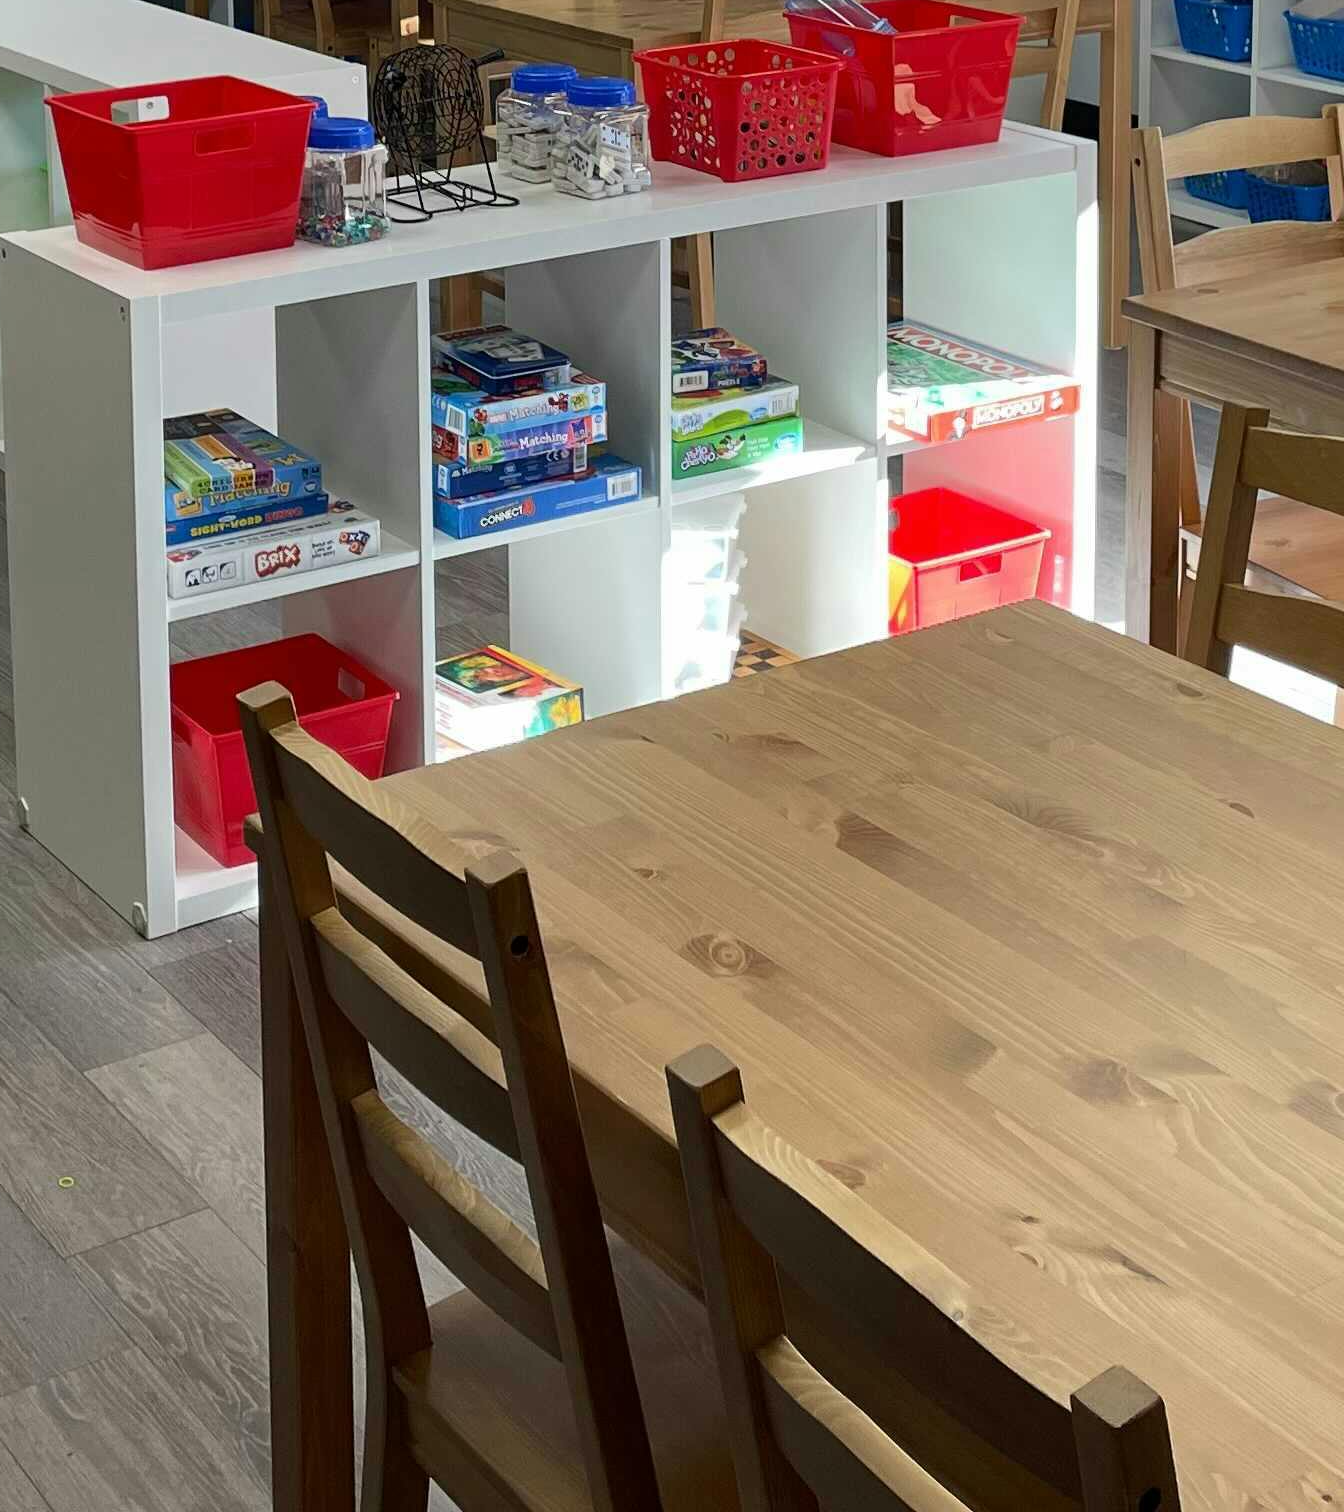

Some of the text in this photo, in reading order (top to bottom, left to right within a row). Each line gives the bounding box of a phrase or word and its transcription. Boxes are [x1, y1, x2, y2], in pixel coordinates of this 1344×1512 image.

[509, 401, 560, 422] Matching
[975, 398, 1043, 426] MONOPOLY
[519, 430, 568, 450] Matching
[480, 504, 523, 528] CONNECT
